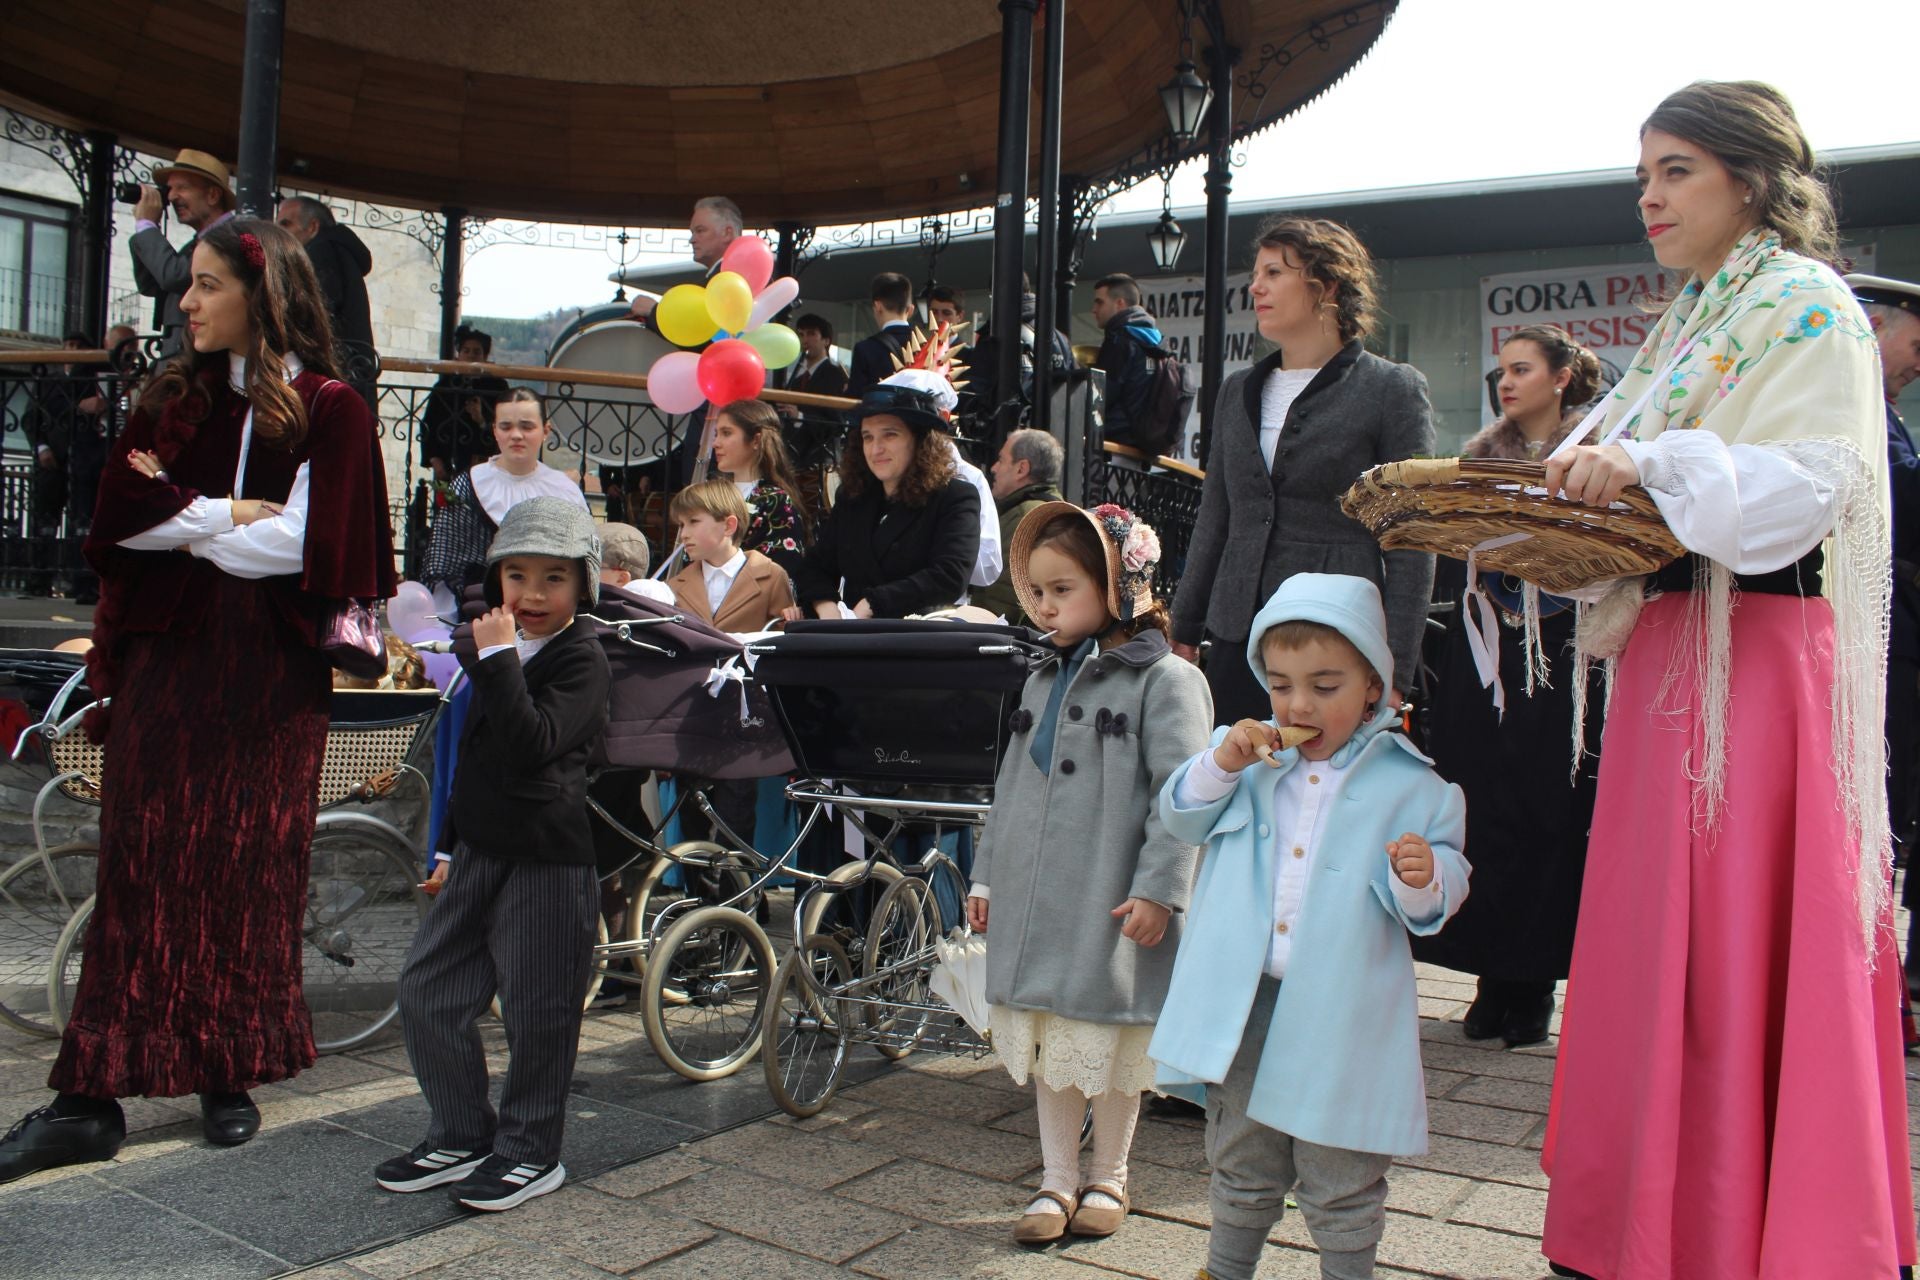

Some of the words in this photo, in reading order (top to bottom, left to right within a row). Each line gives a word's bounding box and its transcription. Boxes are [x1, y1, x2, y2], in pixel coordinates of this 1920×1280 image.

[1140, 288, 1235, 319] AIATZK
[1488, 280, 1596, 316] GORA
[1606, 273, 1675, 307] PAL
